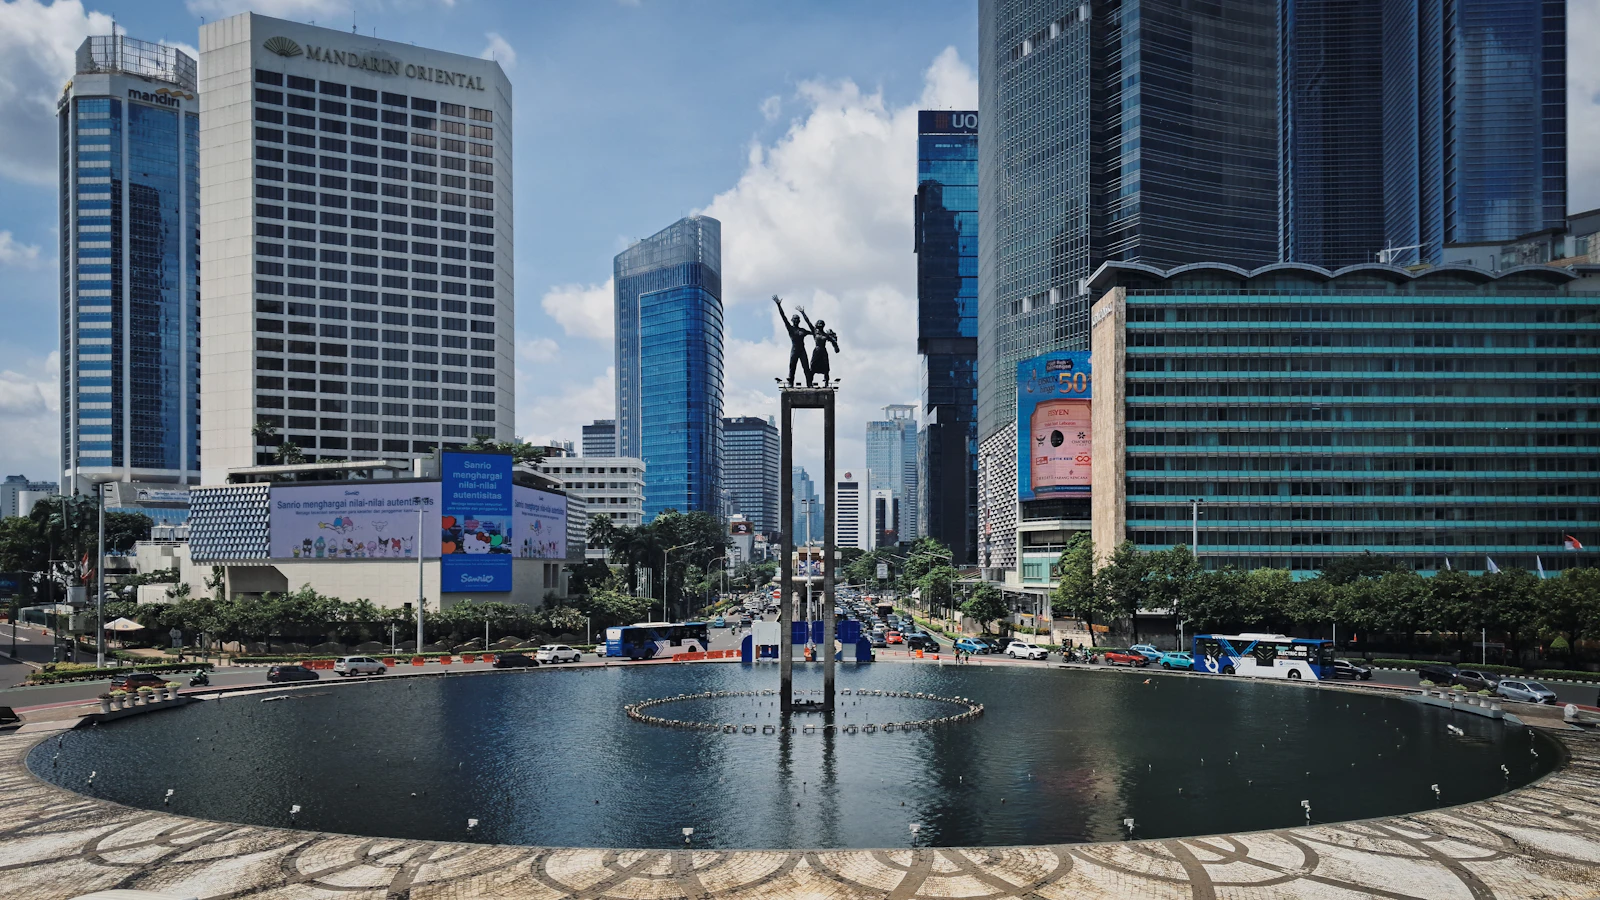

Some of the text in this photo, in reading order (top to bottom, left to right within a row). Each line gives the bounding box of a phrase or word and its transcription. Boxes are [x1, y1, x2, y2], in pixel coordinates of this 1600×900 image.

[306, 44, 485, 91] MANDARIN ORIENTAL
[128, 88, 180, 107] mandiri
[464, 461, 492, 470] Sanrio
[453, 471, 503, 481] menghargai
[458, 481, 497, 490] nilai-nilai
[453, 490, 502, 500] autentisitas
[277, 501, 301, 509] Sanrio
[303, 499, 346, 510] menghargai
[349, 498, 385, 508] nilai-nilai
[460, 573, 494, 584] Sanrio
